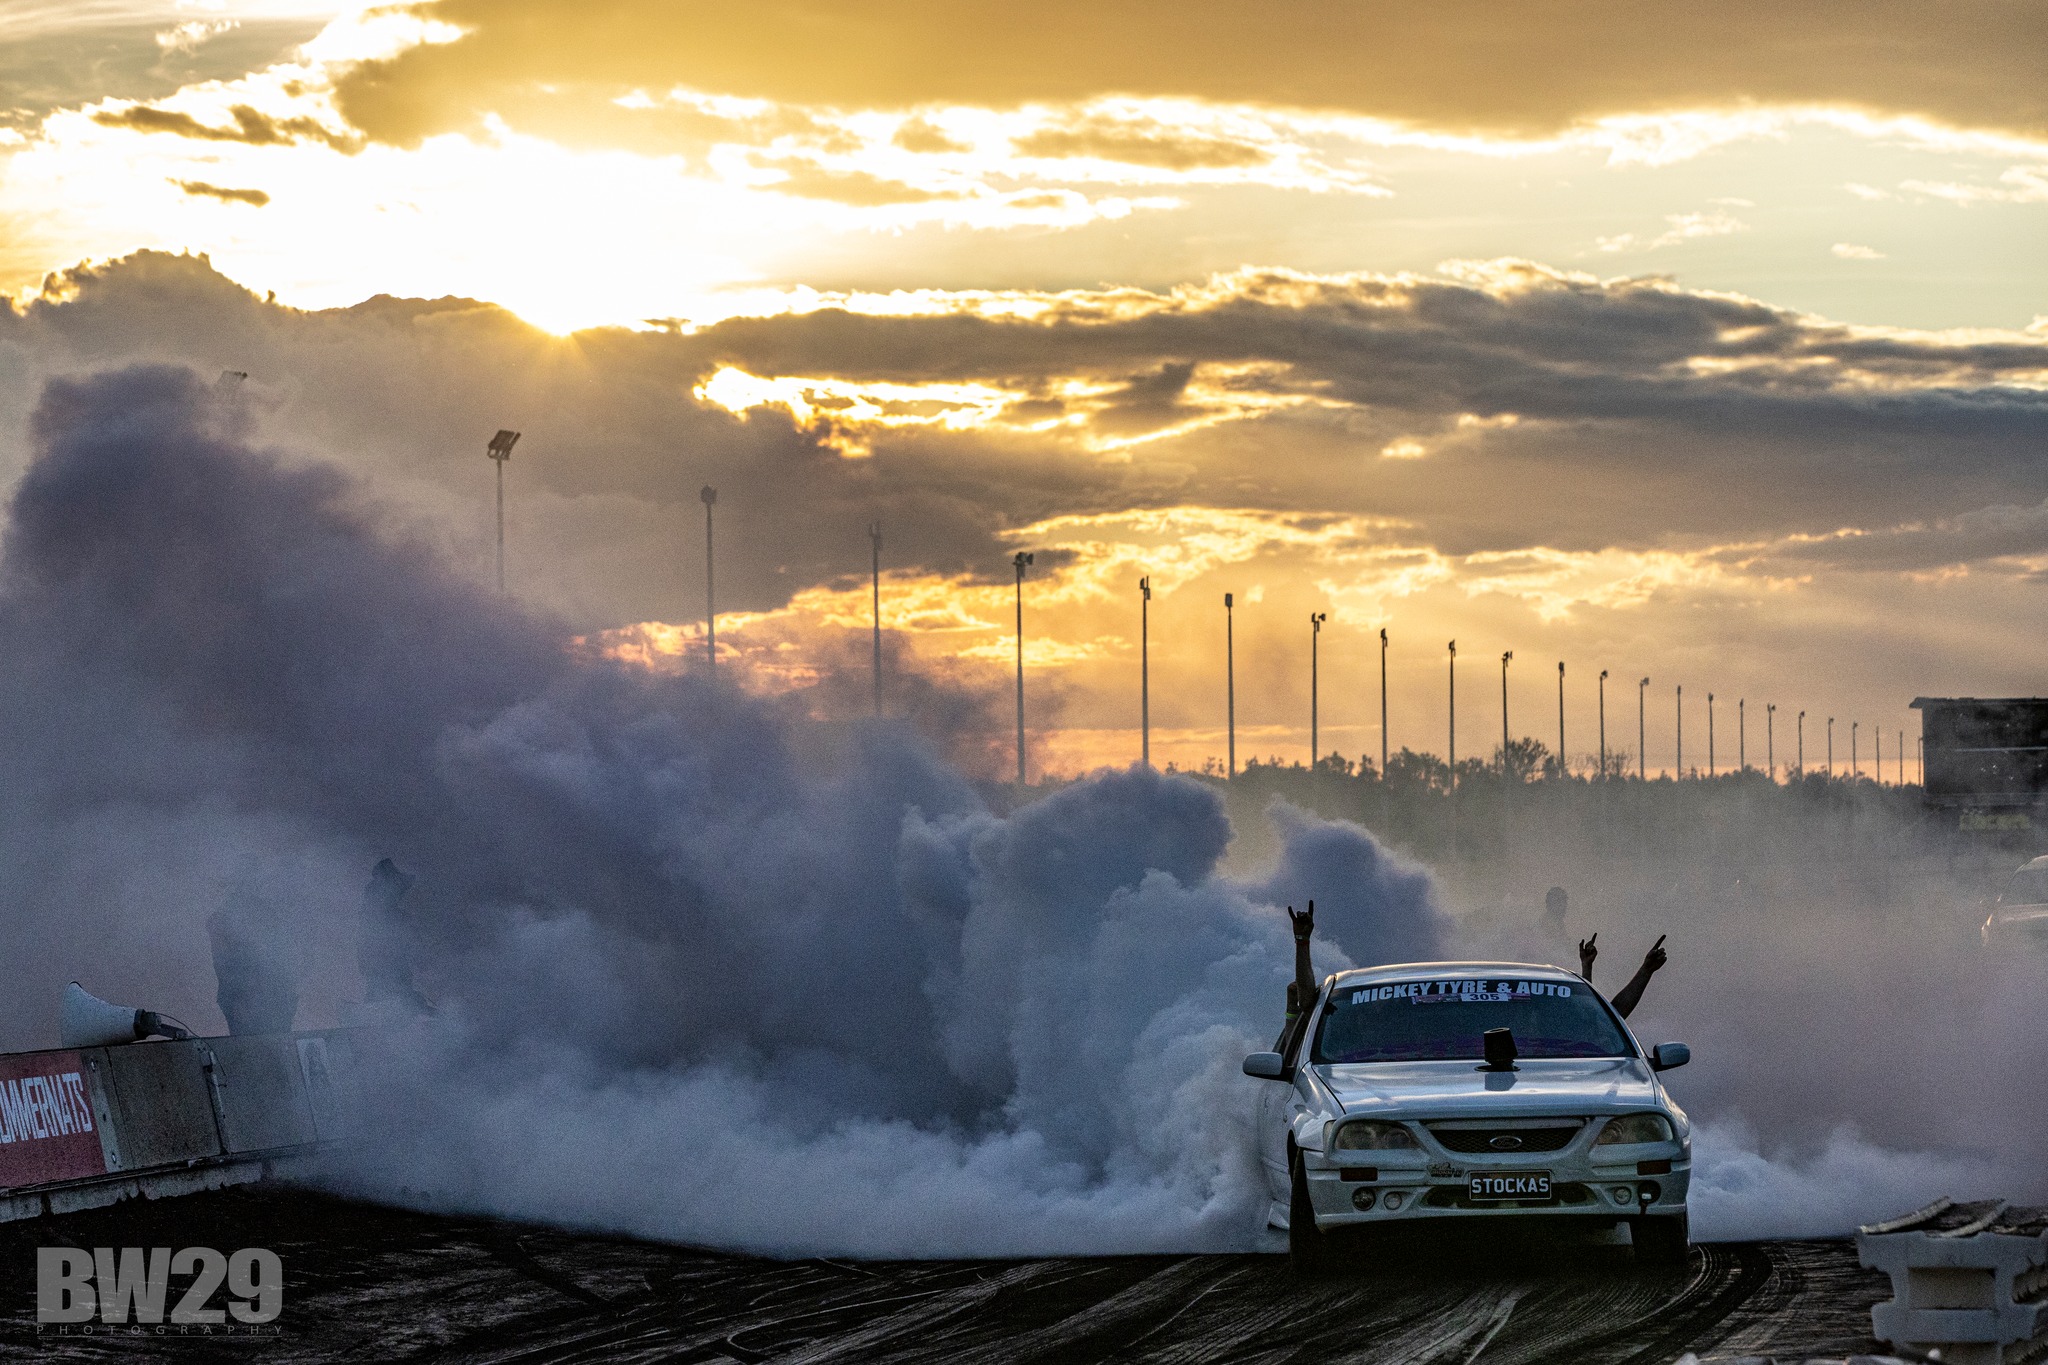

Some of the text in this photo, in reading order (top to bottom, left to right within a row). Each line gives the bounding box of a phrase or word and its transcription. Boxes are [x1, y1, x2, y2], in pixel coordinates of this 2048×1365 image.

[1352, 982, 1432, 1005] MICKEY
[1438, 980, 1488, 995] TYRE
[1496, 982, 1513, 994] &
[1515, 981, 1572, 998] AUTO
[1469, 993, 1500, 1001] 305
[0, 1072, 94, 1144] UMMERNATS
[1471, 1177, 1550, 1194] STOCKAS
